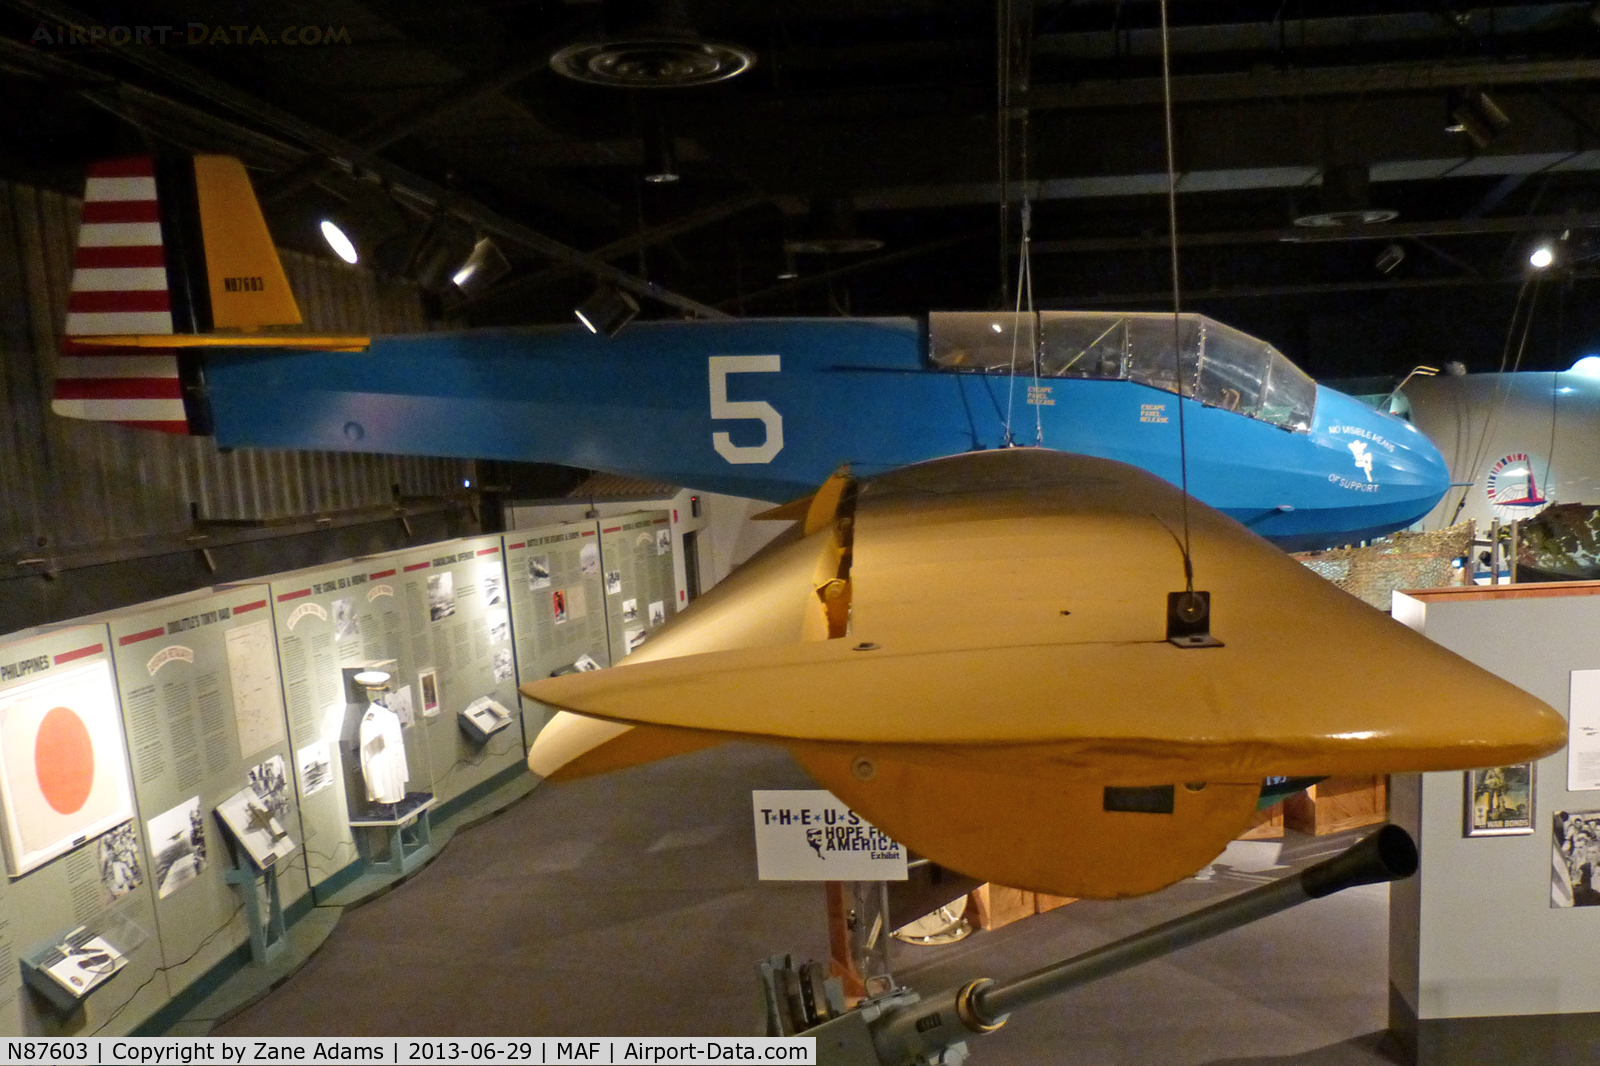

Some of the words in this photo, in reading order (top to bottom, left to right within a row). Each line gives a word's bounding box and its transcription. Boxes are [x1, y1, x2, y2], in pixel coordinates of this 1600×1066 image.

[708, 354, 785, 465] 5
[1328, 426, 1341, 434] NO
[1342, 426, 1372, 440] VISIBLE
[1371, 433, 1396, 453] MEANS
[1328, 473, 1340, 484] OF
[1339, 478, 1379, 493] SUPPORT
[0, 654, 50, 681] PHILIPPINES
[1487, 820, 1504, 828] WAR
[1504, 819, 1529, 828] BONDS
[825, 826, 864, 840] HOPE
[825, 837, 899, 851] AMERICA
[871, 852, 900, 860] Exhibit
